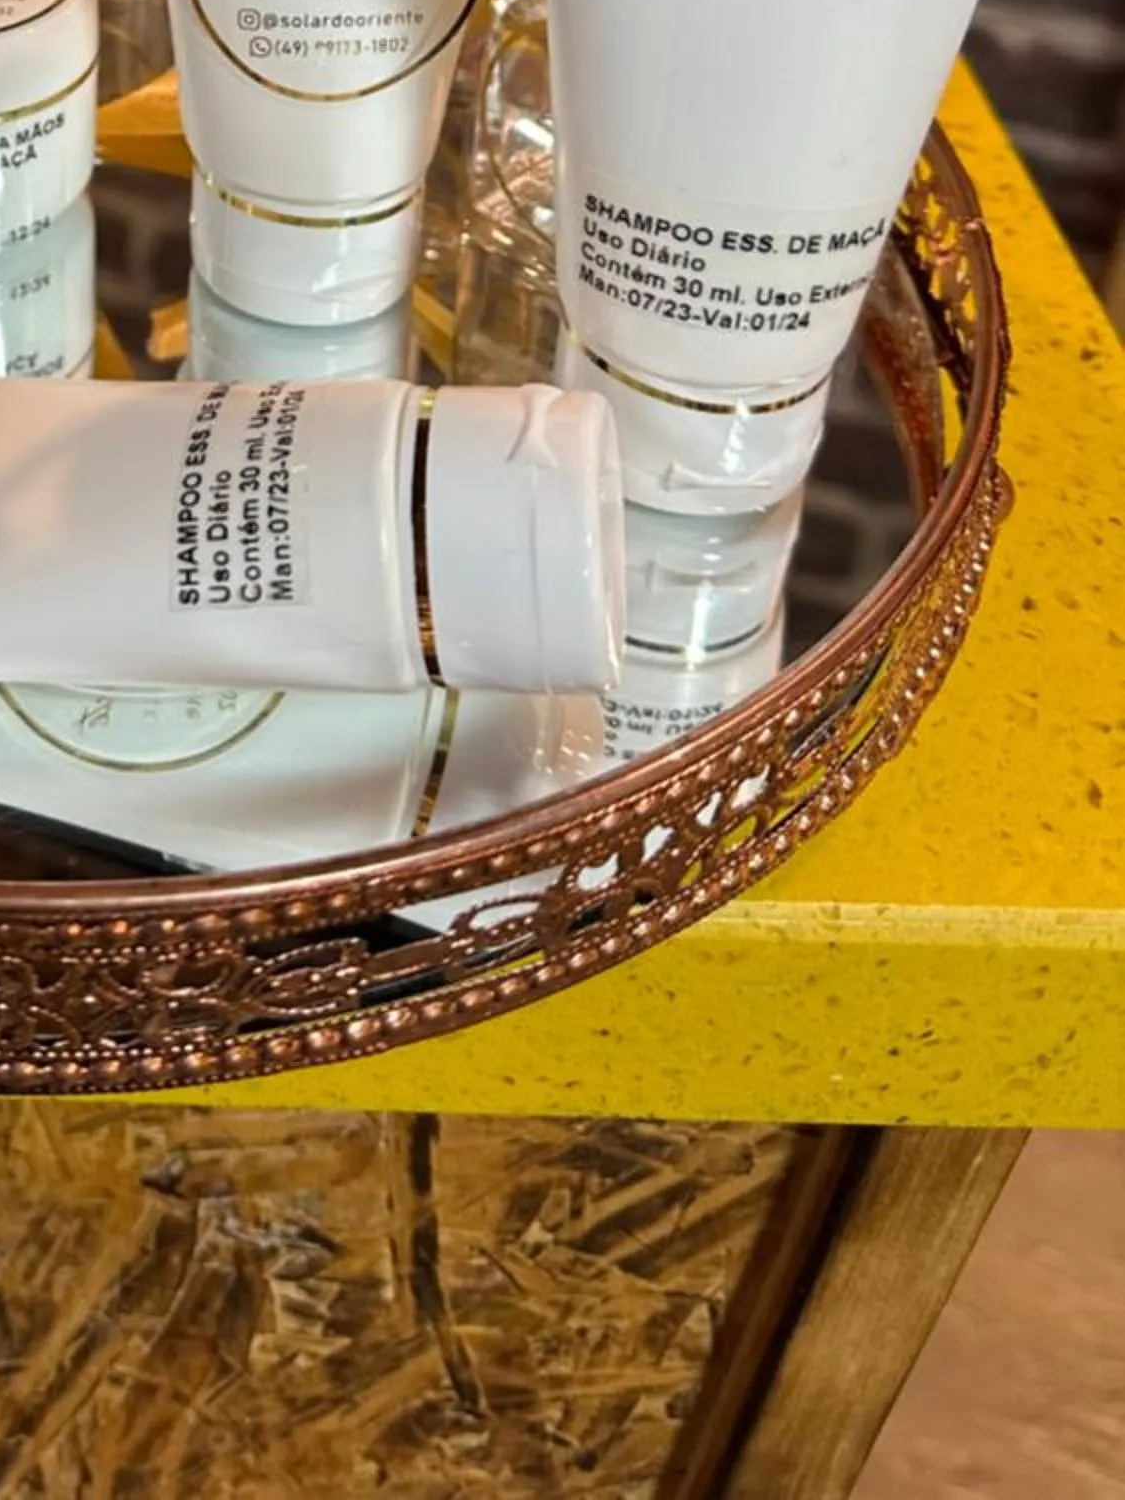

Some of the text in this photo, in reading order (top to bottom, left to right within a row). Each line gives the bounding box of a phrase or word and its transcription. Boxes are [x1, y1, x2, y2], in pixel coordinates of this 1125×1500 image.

[262, 9, 425, 30] @solardooriente
[275, 40, 309, 57] (49)
[583, 217, 707, 273] Uso Diário
[584, 194, 714, 246] SHAMPOO
[721, 230, 779, 255] ESS.
[787, 235, 823, 255] DE
[580, 241, 666, 290] Contém
[672, 276, 703, 299] 30
[710, 285, 747, 305] ml.
[755, 288, 803, 307] Uso
[238, 465, 261, 493] 30
[176, 471, 203, 606] SHAMPOO
[206, 469, 233, 604] Uso Diário
[237, 497, 263, 604] Contém
